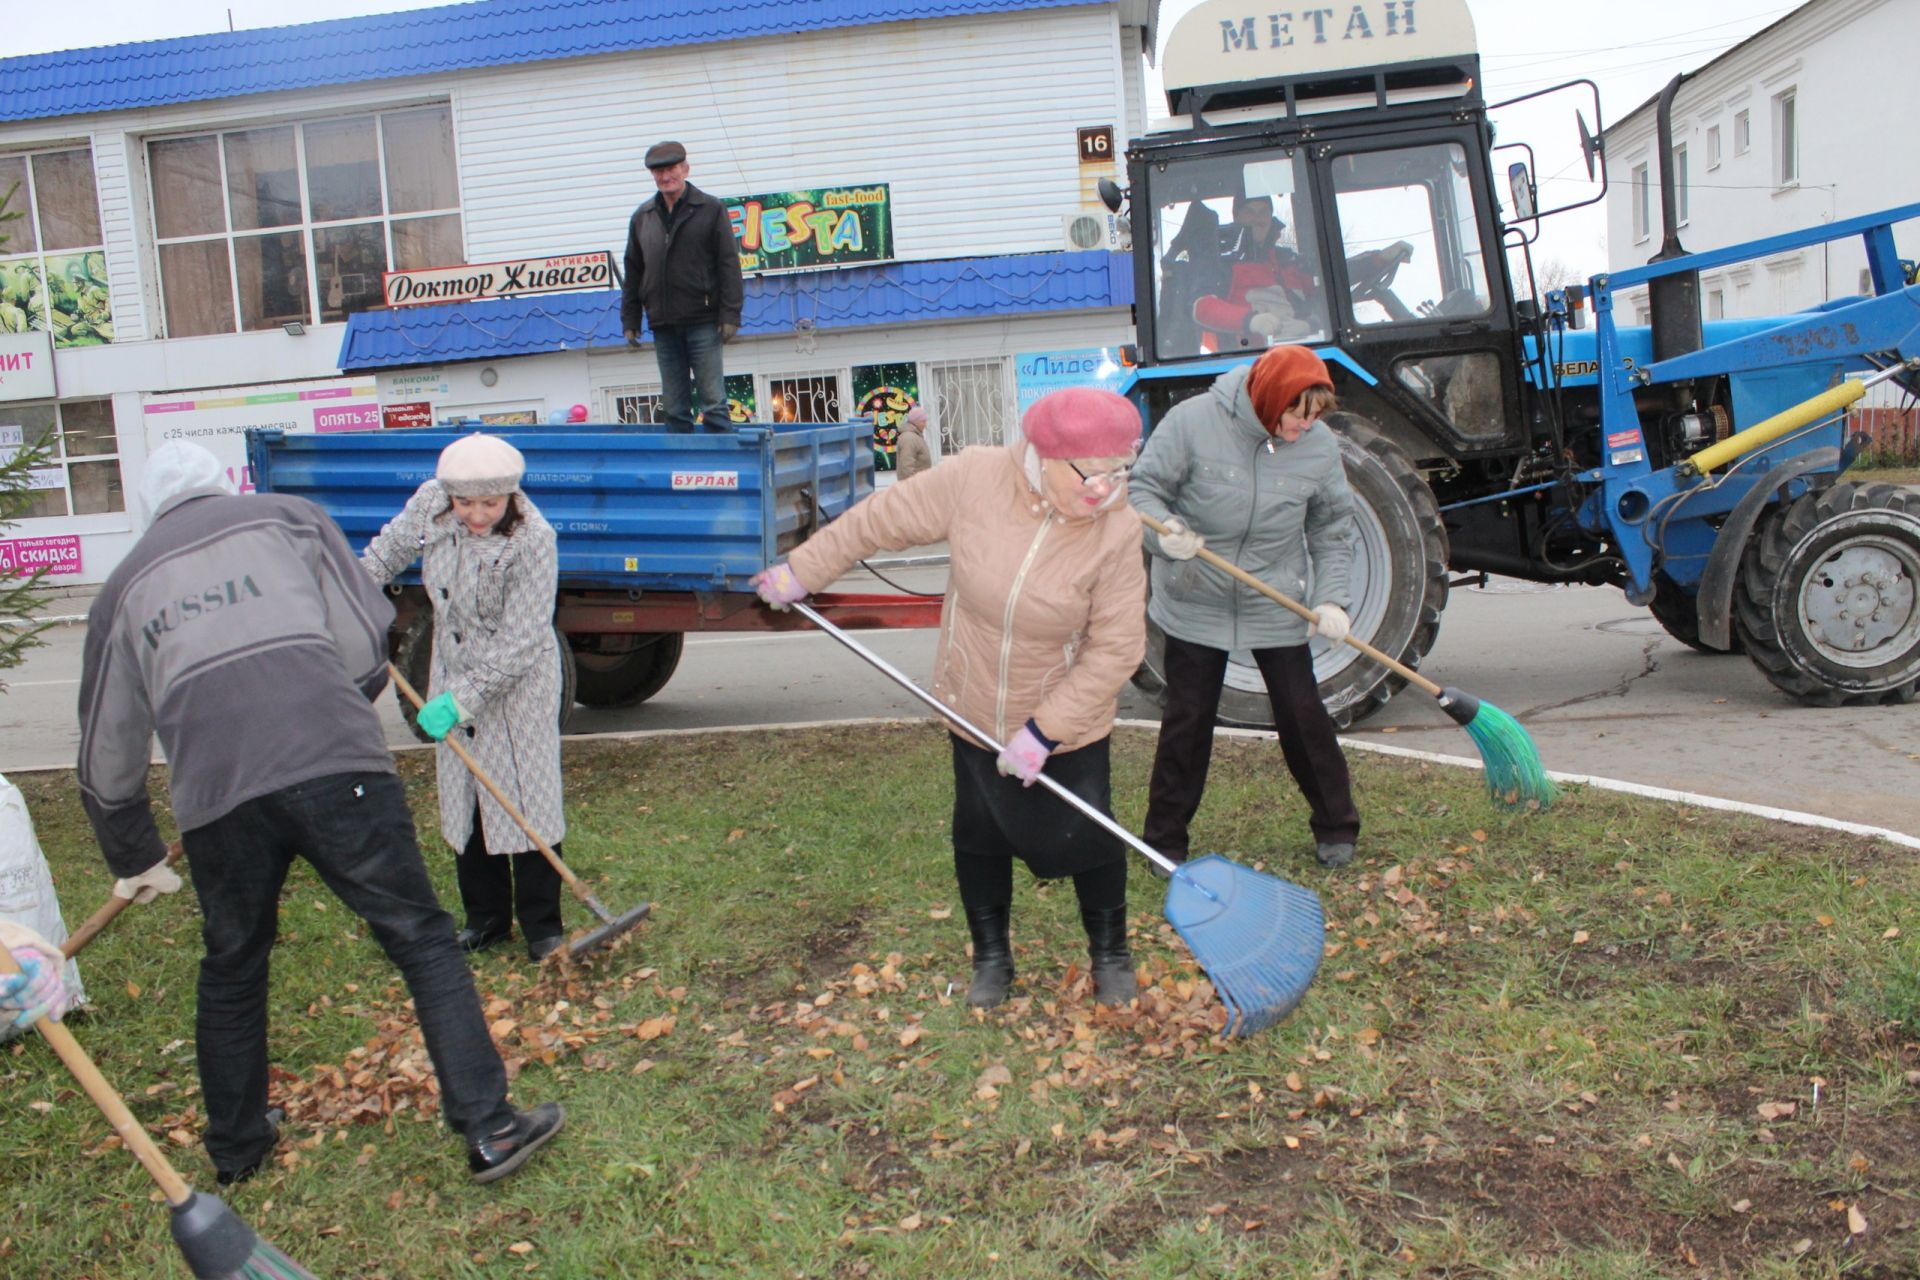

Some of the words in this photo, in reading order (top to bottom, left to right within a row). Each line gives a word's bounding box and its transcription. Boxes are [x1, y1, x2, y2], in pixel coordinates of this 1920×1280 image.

[1219, 0, 1417, 53] МЕТАН
[1084, 135, 1108, 153] 16
[825, 190, 884, 206] fast-food
[1108, 214, 1117, 245] BEKO
[545, 253, 607, 268] АНТИКАФЕ
[387, 272, 493, 302] Доктор
[496, 263, 608, 292] Живаго
[392, 375, 440, 385] БАНКОМАТ
[319, 412, 362, 427] ОПЯТЬ
[364, 410, 379, 423] 25
[171, 428, 183, 438] 25
[185, 426, 214, 437] числа
[674, 475, 737, 487] БУРЛАК
[20, 547, 78, 563] скидка
[142, 575, 263, 650] RUSSIA
